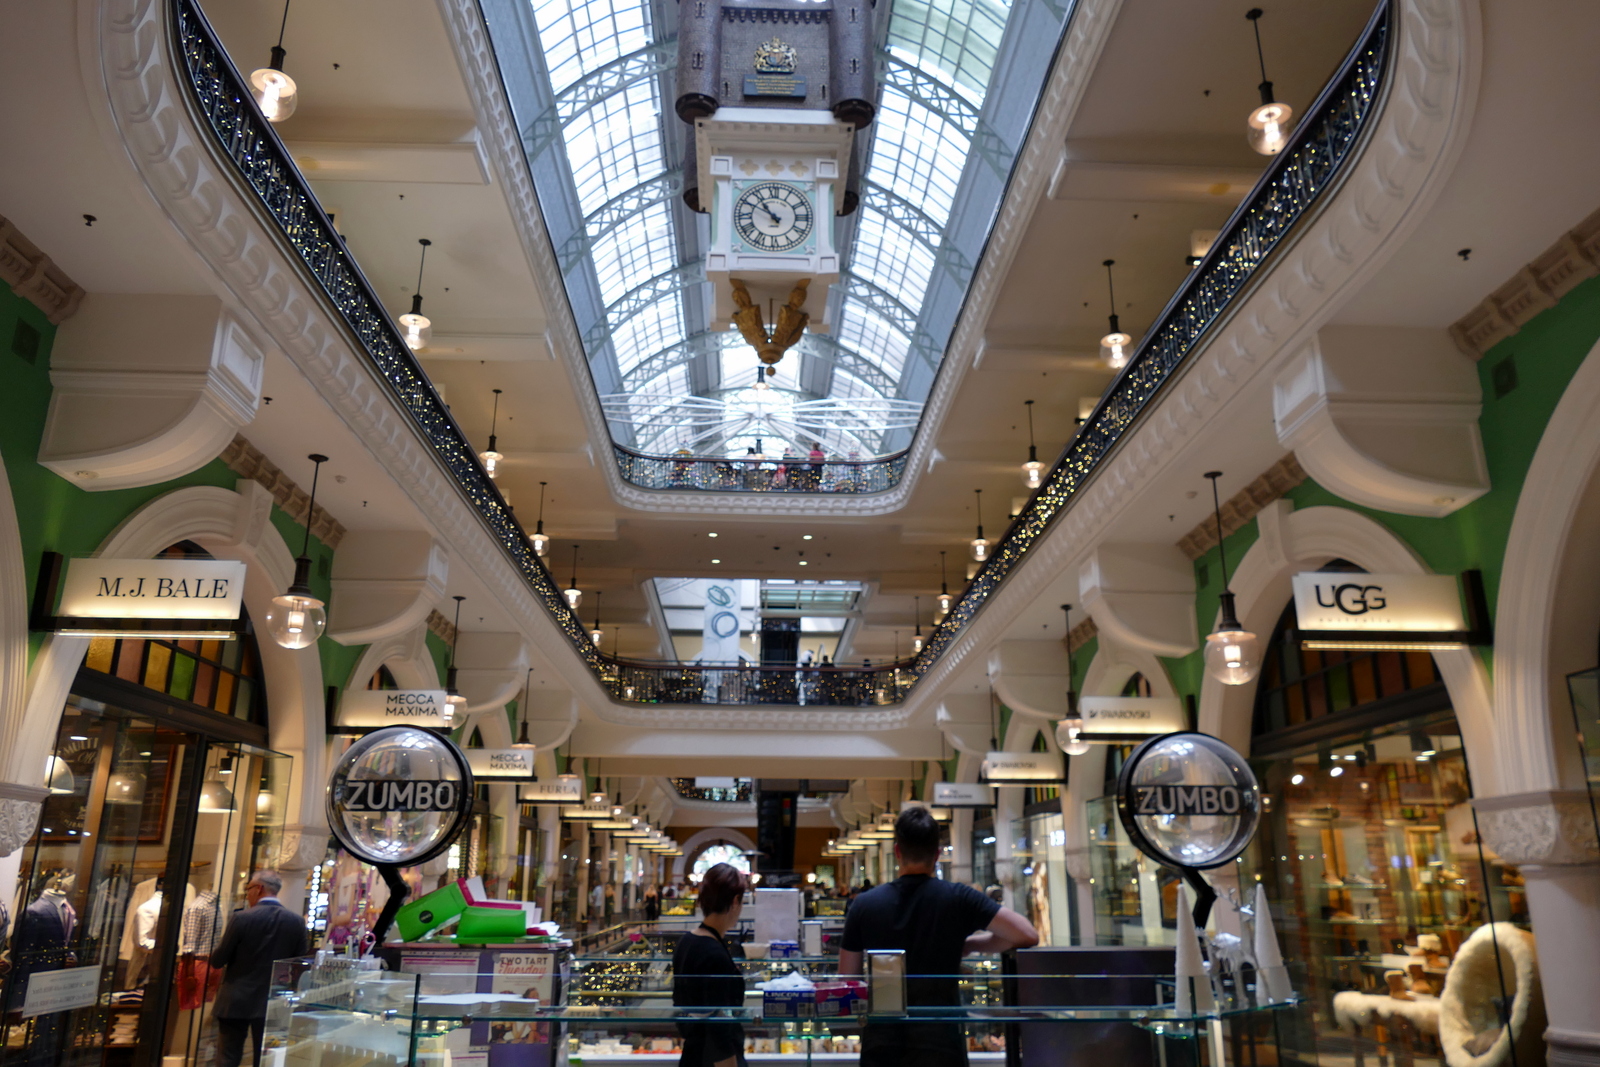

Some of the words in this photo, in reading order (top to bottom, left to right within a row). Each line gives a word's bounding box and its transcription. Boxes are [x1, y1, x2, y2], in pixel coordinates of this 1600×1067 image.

[96, 576, 146, 598] M.J.
[154, 577, 229, 599] BALE
[1314, 583, 1387, 616] UGG
[386, 694, 435, 705] MECCA
[385, 706, 438, 717] MAXIMA
[490, 753, 525, 762] MECCA
[489, 763, 528, 771] MAXIMA
[540, 785, 578, 794] FURLA
[347, 782, 454, 810] ZUMBO
[1139, 786, 1240, 814] ZUMBO
[500, 956, 522, 965] TWO
[525, 956, 548, 965] TART
[498, 962, 547, 980] Tuesday
